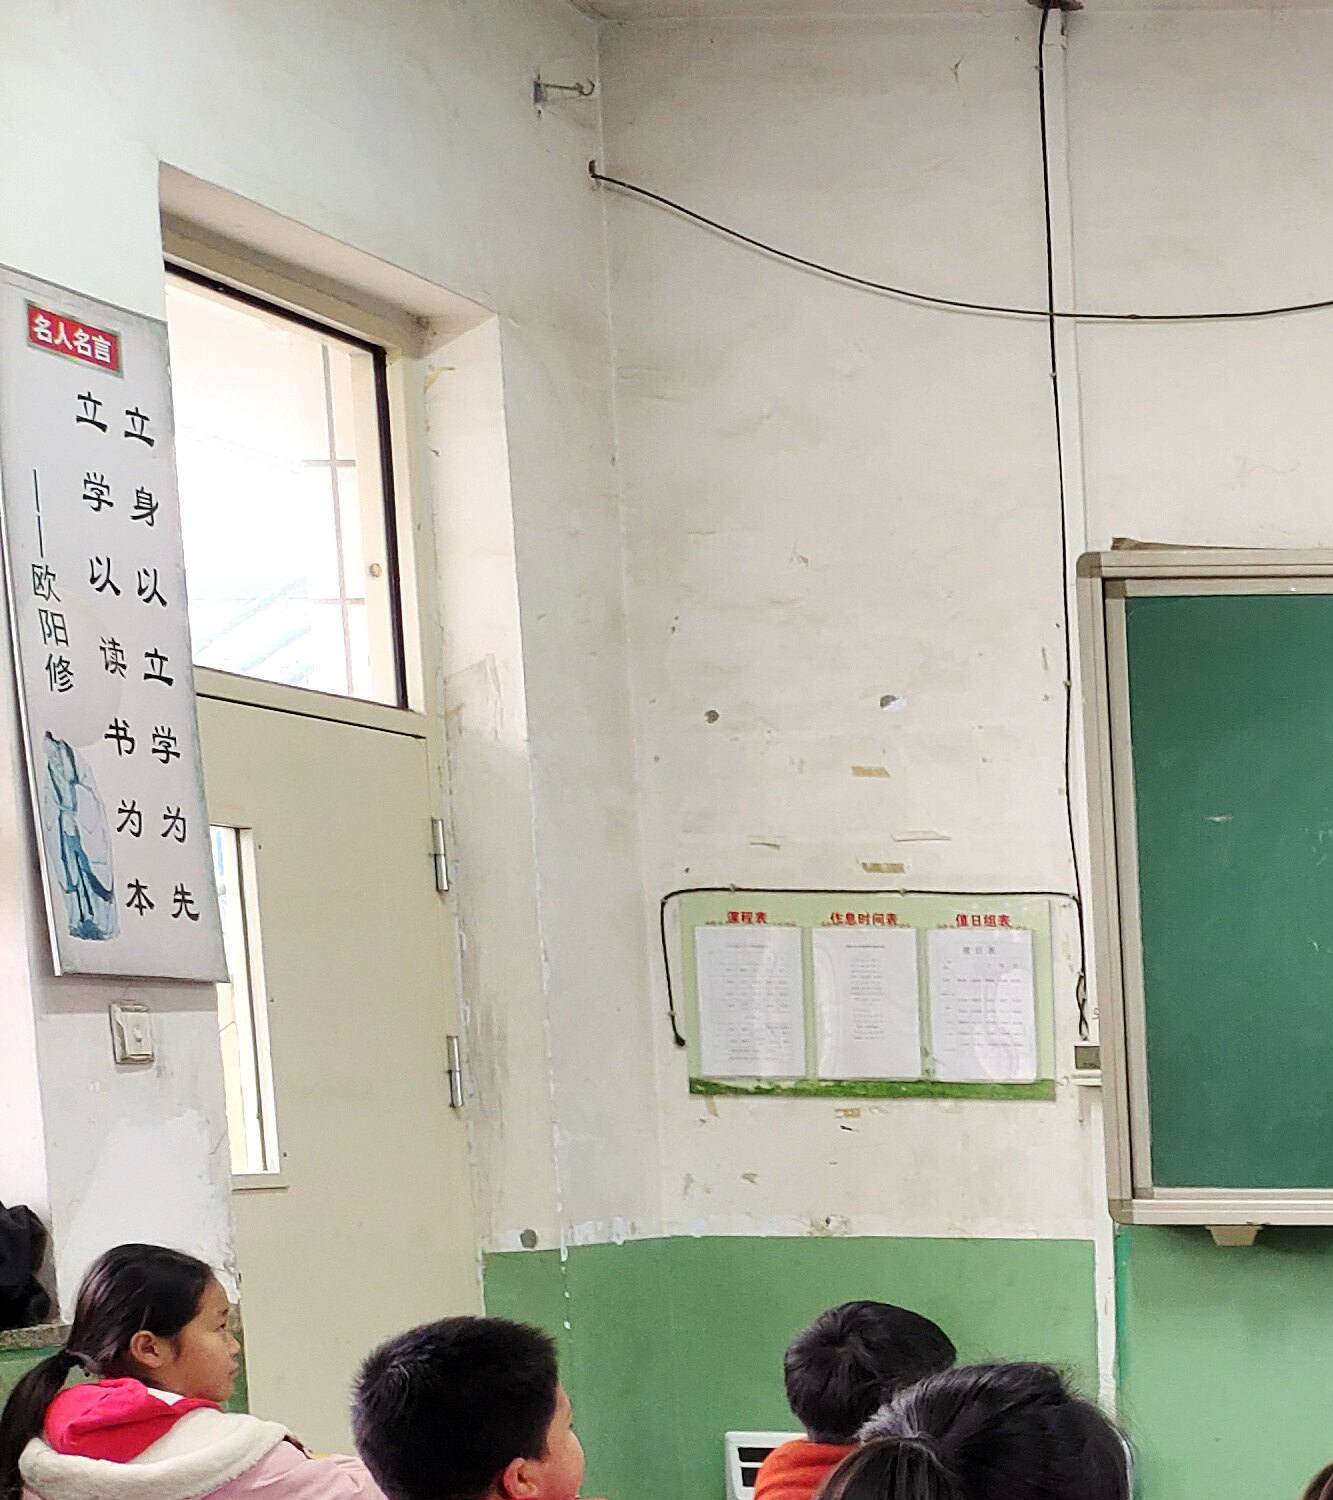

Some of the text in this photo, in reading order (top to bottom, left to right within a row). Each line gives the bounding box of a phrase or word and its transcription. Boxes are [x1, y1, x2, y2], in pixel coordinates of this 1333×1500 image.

[32, 313, 114, 366] 名人名言
[75, 389, 156, 917] 立学以读书为本
[123, 405, 200, 923] 立身以立学为先
[727, 912, 768, 925] 课程表
